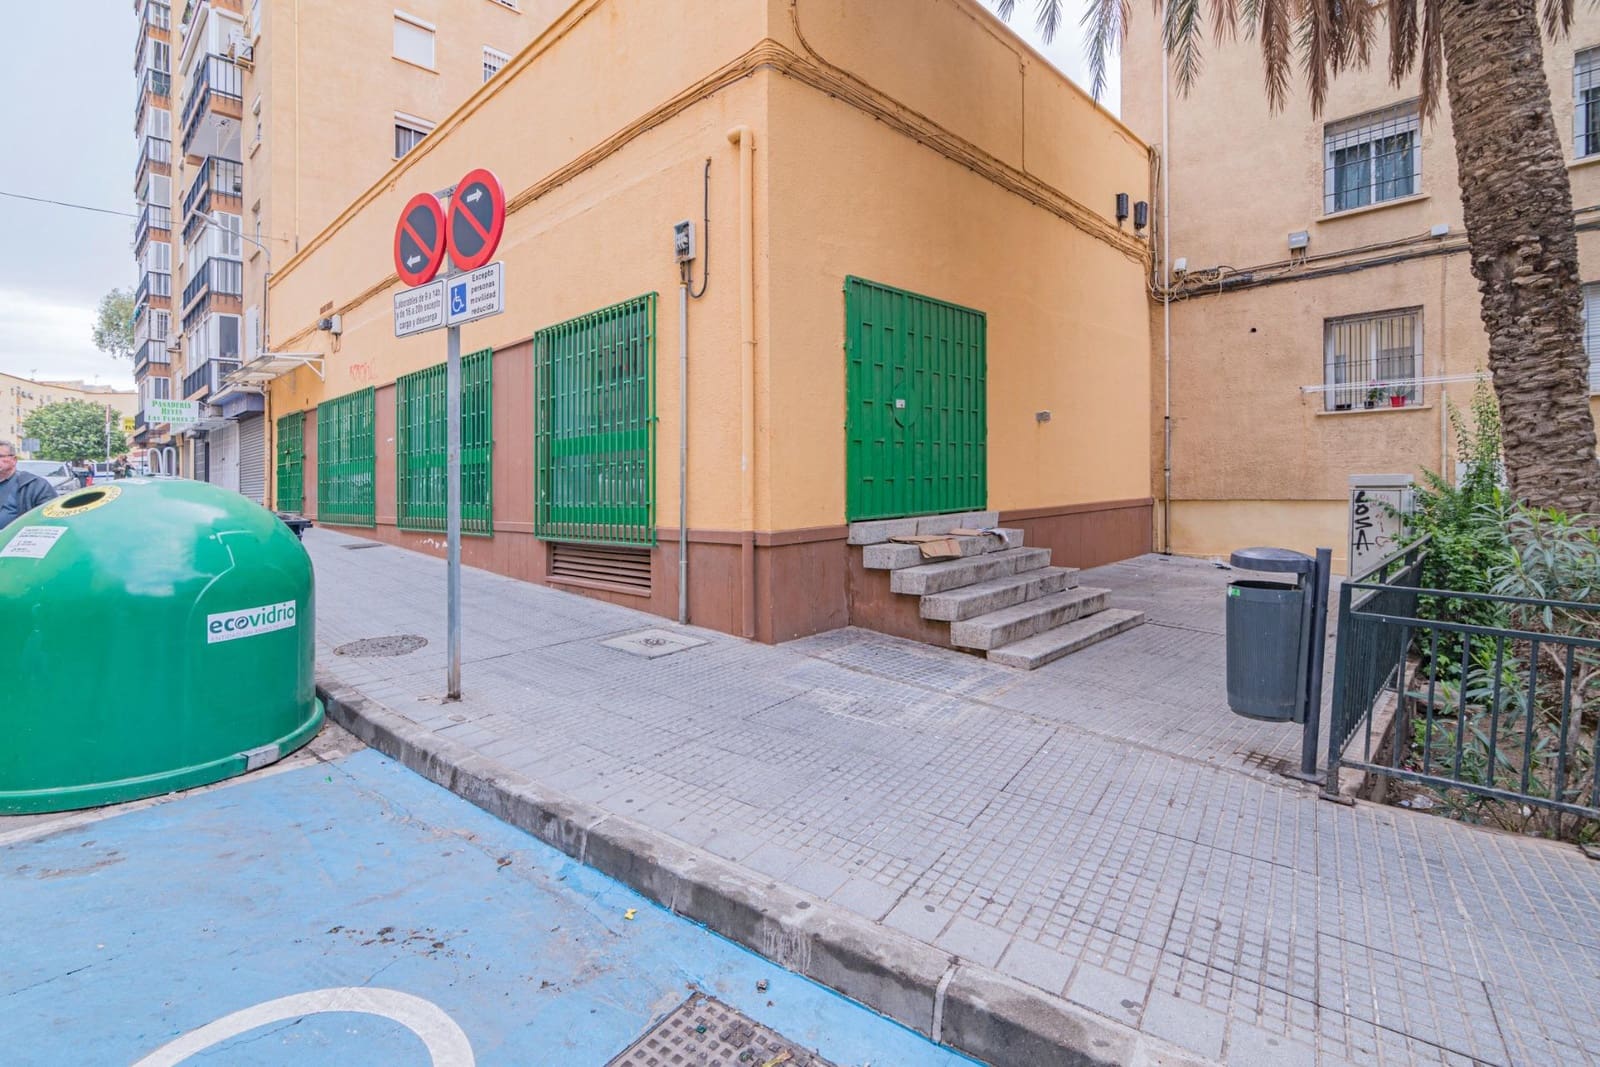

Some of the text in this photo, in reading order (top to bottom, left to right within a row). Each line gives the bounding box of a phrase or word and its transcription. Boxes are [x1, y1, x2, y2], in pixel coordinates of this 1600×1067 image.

[472, 269, 494, 282] Excepto
[471, 281, 495, 294] personas
[419, 295, 424, 303] de
[470, 290, 496, 304] movilidad
[400, 310, 405, 318] de
[424, 300, 441, 312] excepto
[471, 303, 494, 315] reducida
[400, 320, 412, 330] carga
[416, 312, 438, 325] descarga
[209, 603, 295, 633] ecovidrio
